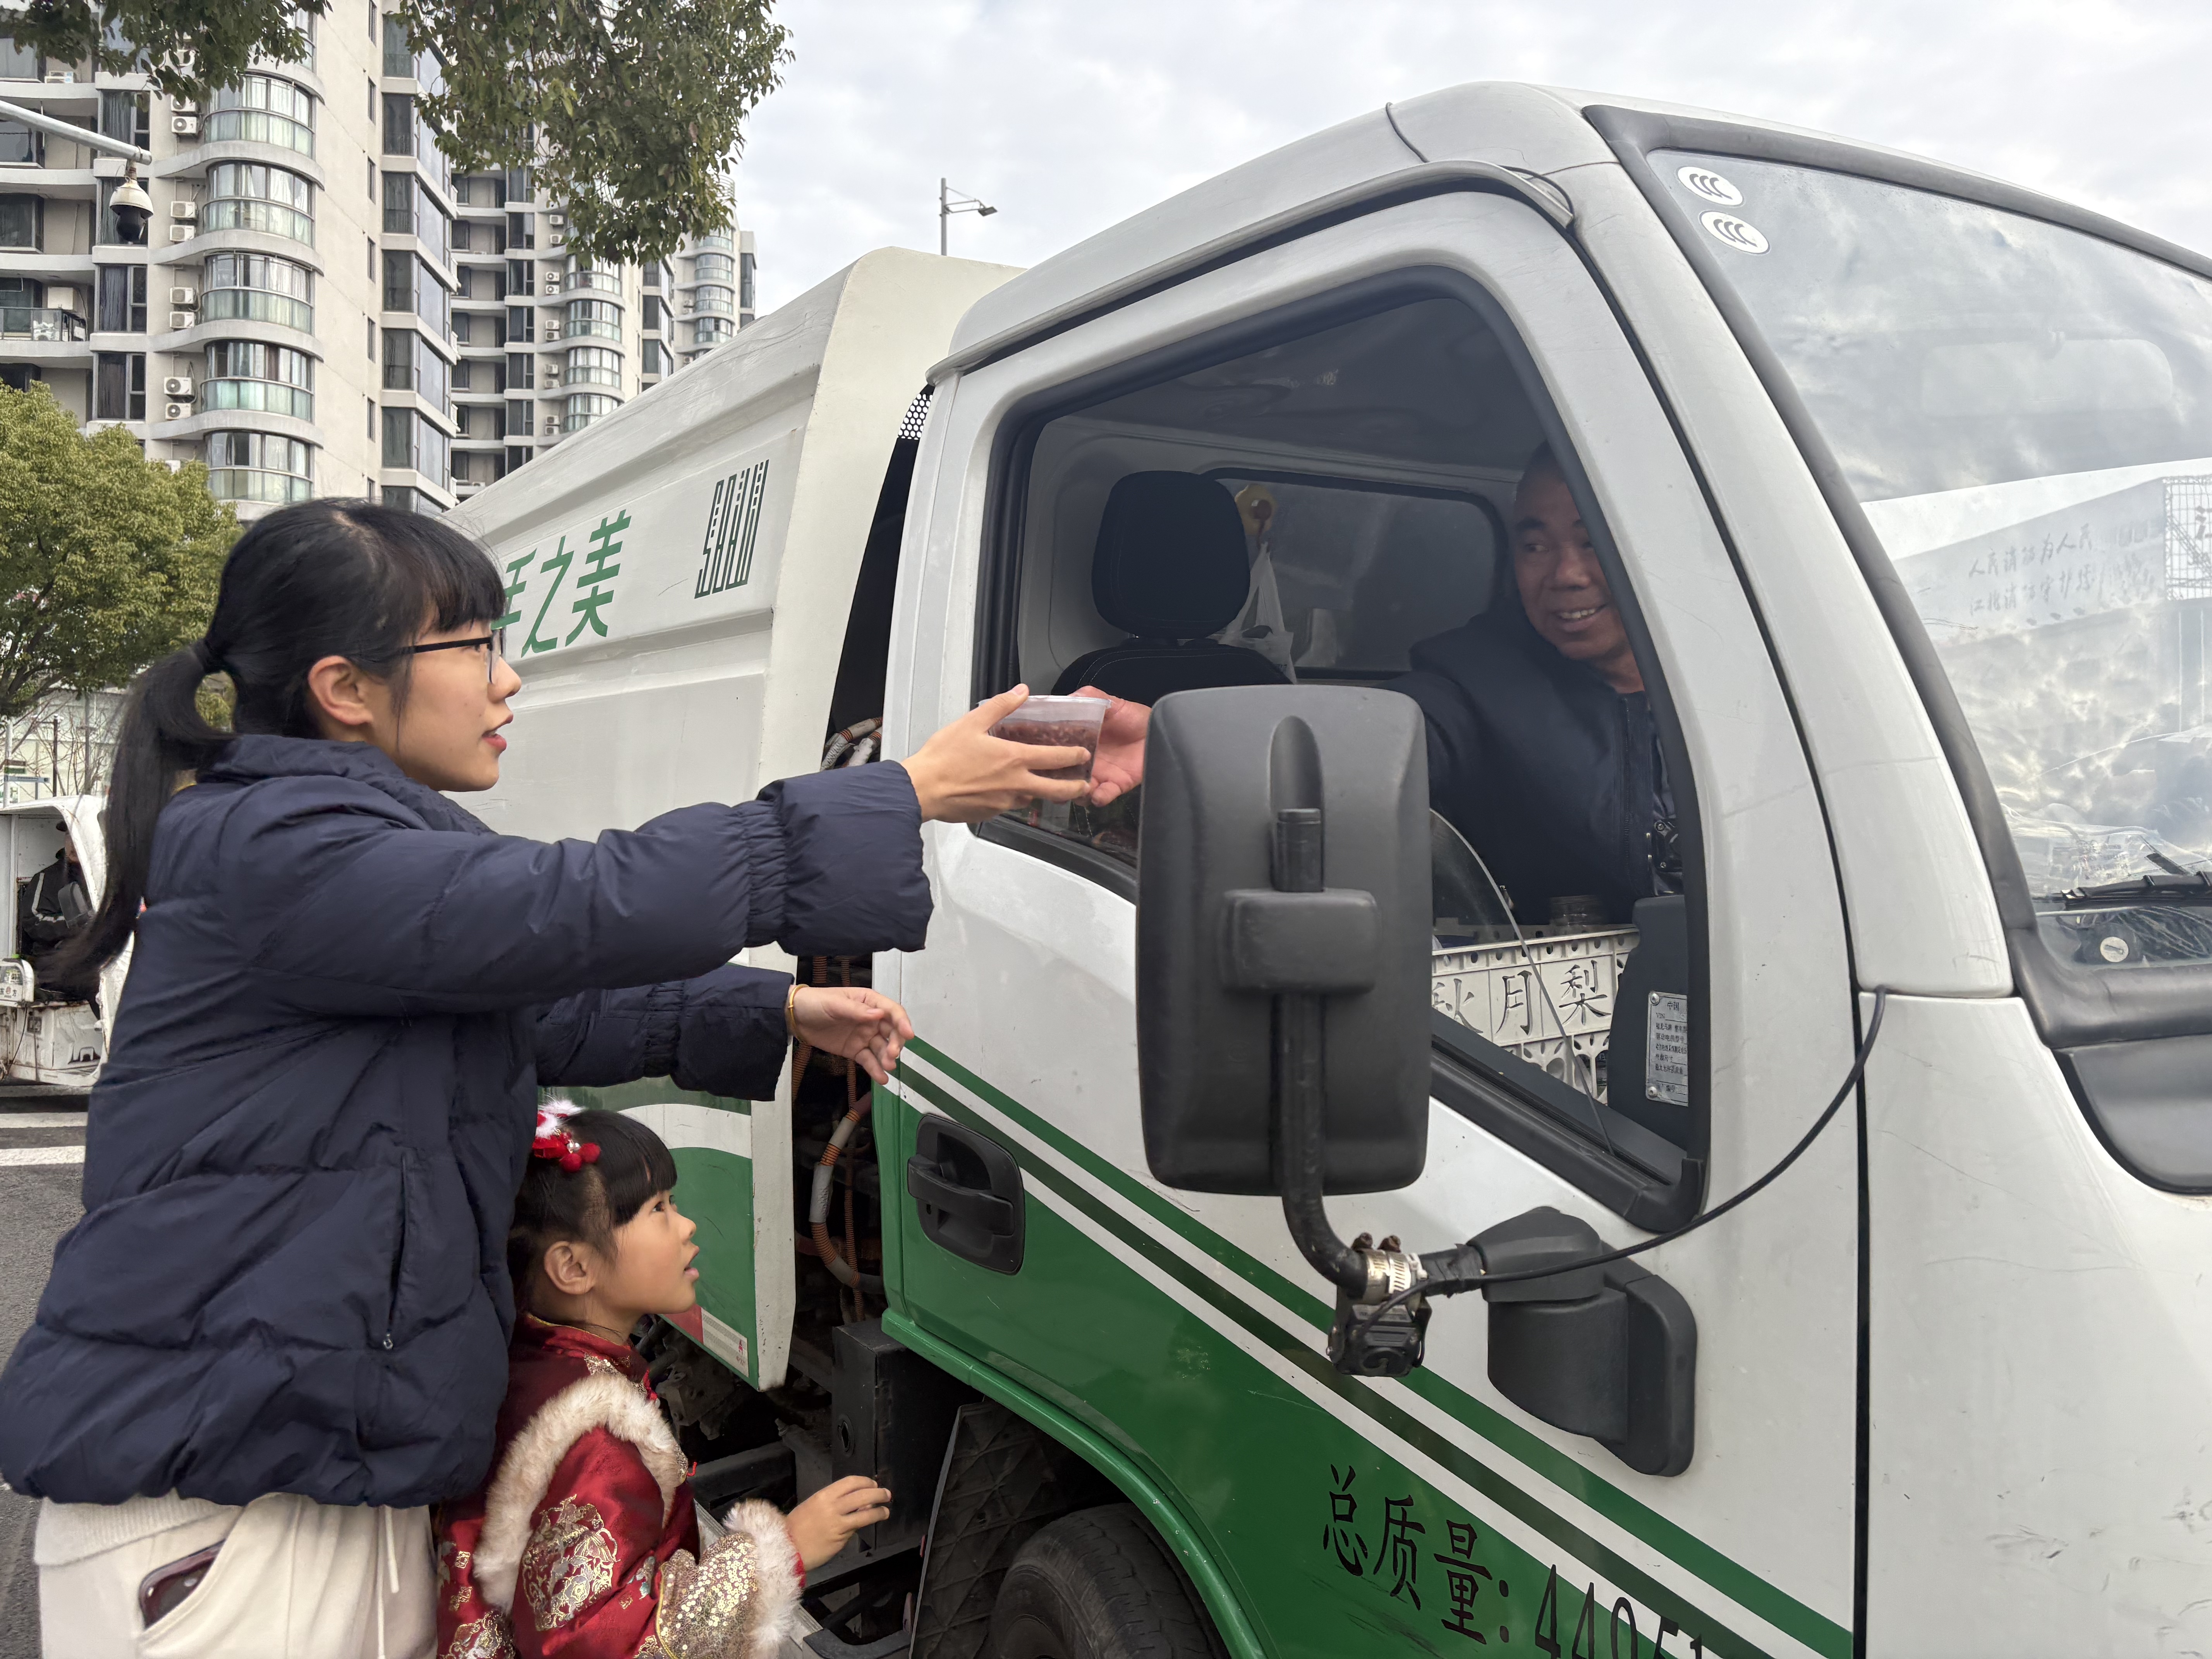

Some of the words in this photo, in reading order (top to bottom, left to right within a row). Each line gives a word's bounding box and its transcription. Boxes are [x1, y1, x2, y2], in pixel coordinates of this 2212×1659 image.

[1689, 173, 1733, 200] CCC
[1713, 219, 1758, 247] CCC
[1323, 1464, 1702, 1659] 总质量:440
